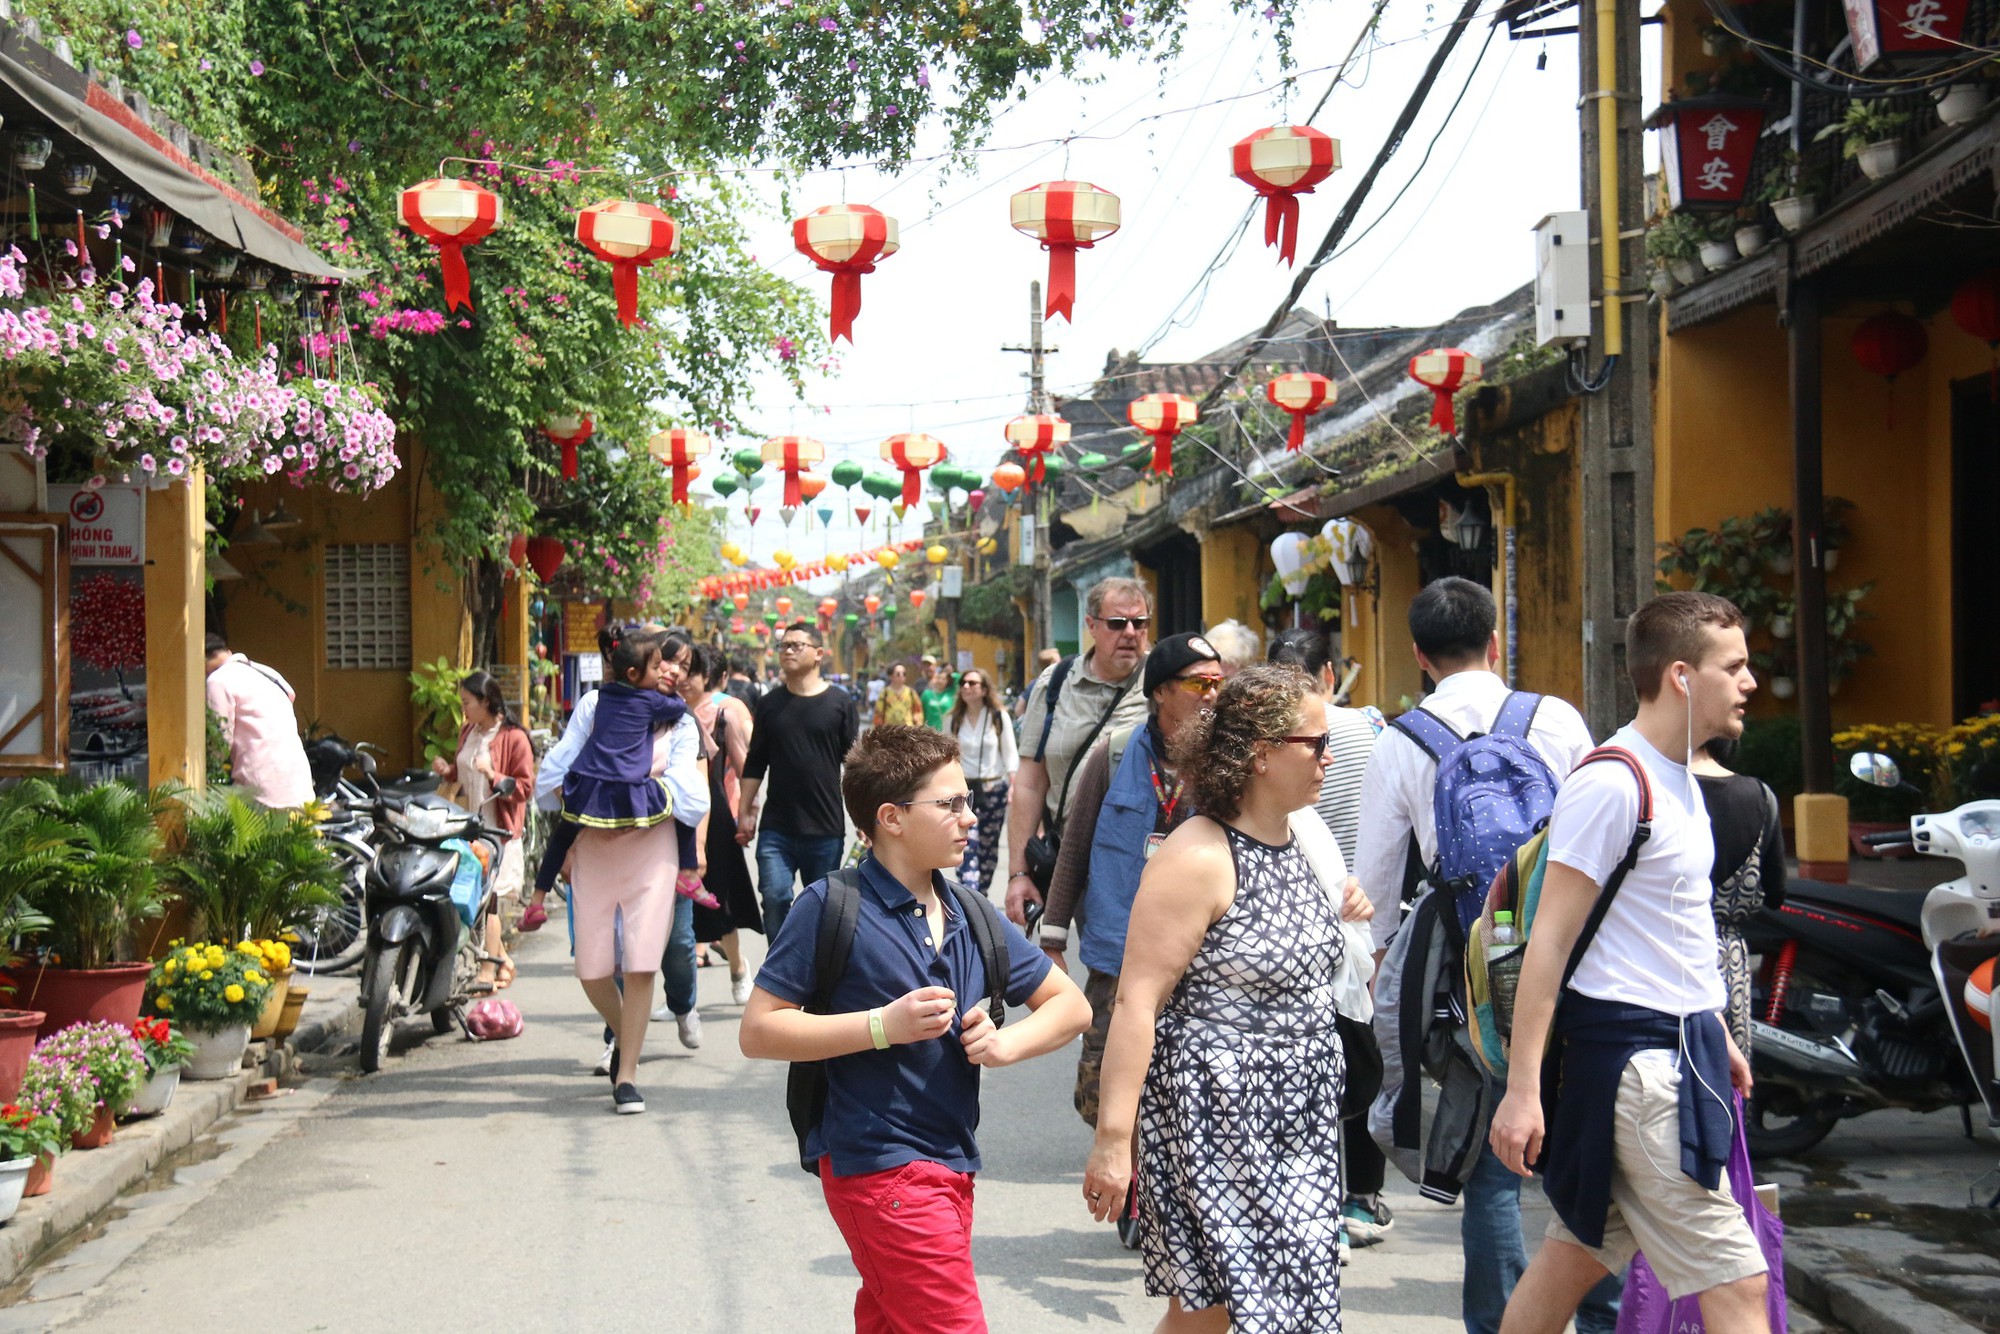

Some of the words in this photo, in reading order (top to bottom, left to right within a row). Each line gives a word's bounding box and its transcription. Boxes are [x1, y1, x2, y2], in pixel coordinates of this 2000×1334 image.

[70, 525, 113, 542] HÔNG
[99, 545, 132, 559] TRANH
[1679, 1321, 1706, 1334] AR
